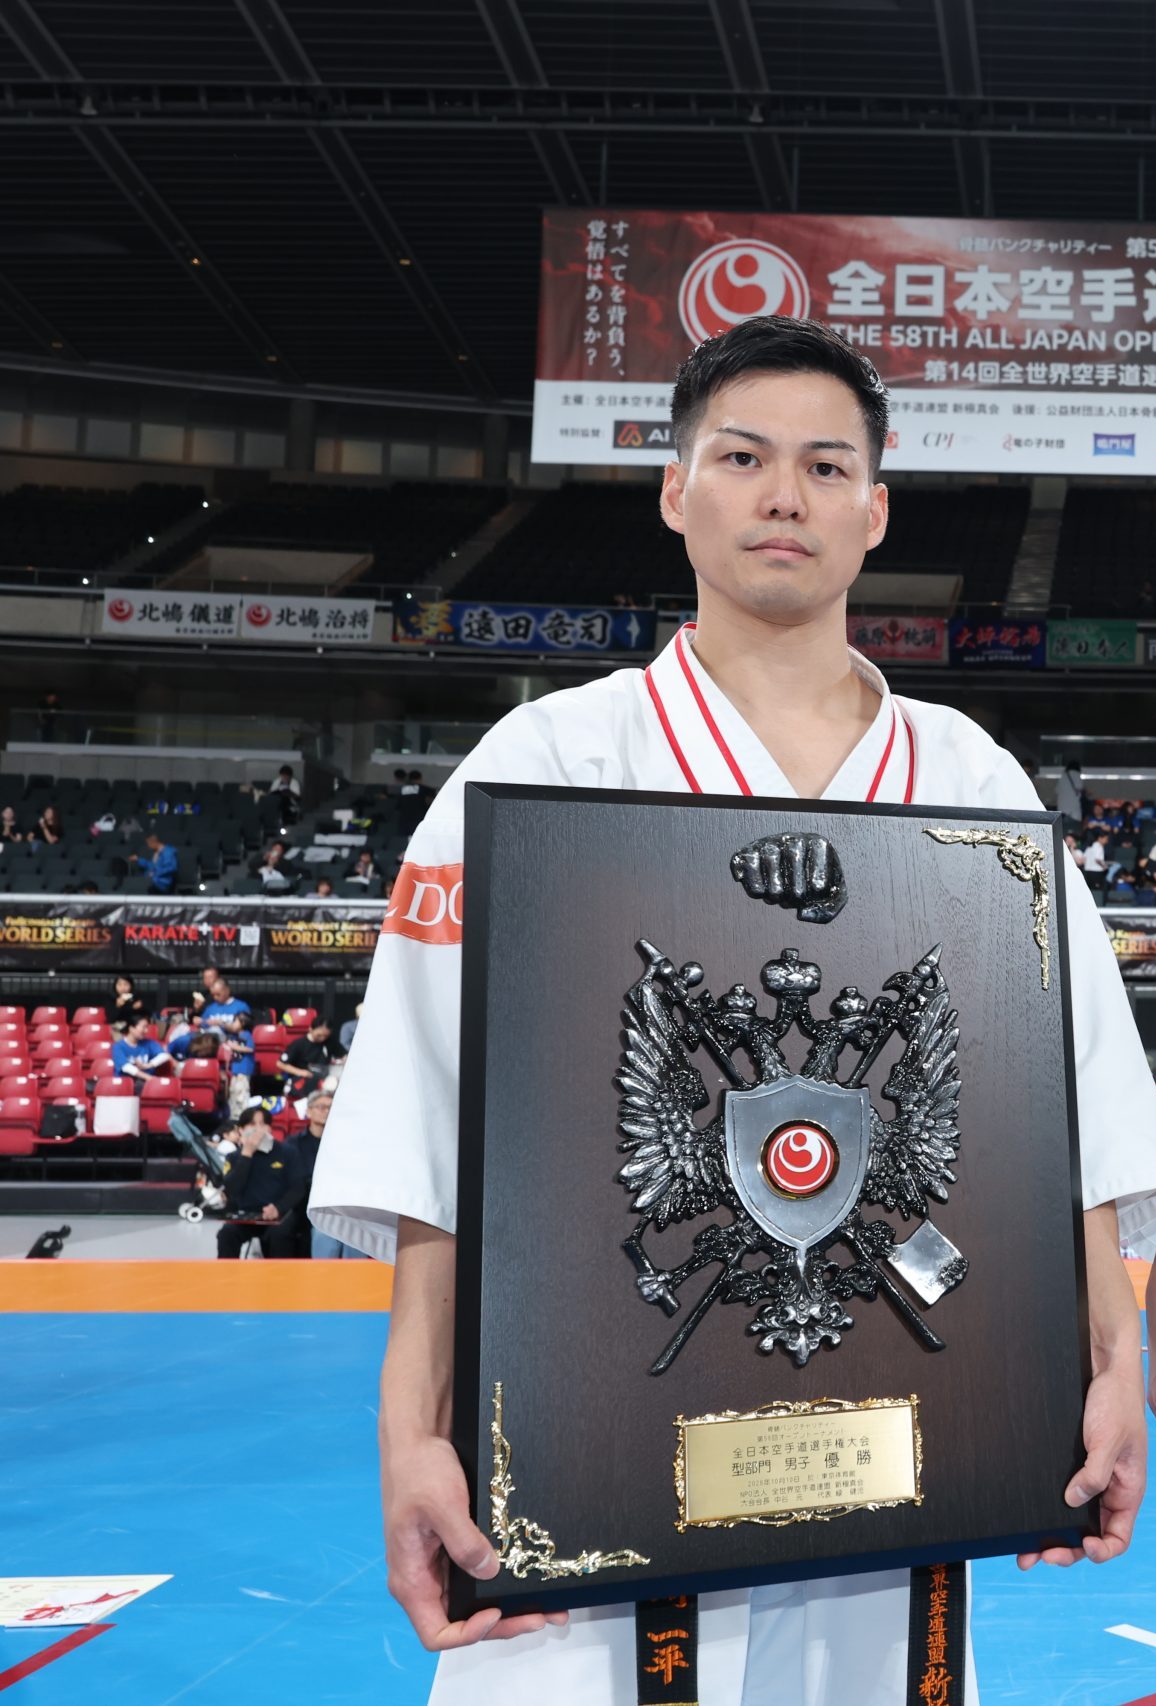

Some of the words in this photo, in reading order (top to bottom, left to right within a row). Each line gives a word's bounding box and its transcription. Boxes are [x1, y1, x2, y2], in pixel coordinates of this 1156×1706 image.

[607, 220, 629, 376] すべてを背負う、
[889, 325, 958, 348] 58TH
[965, 328, 1014, 350] ALL
[1016, 329, 1106, 351] JAPAN
[124, 925, 199, 941] KARATE
[271, 929, 335, 946] WORLD
[732, 1435, 870, 1459] 全日本空手道選手権大会
[731, 1459, 771, 1477] 型部門
[784, 1456, 810, 1472] 男子
